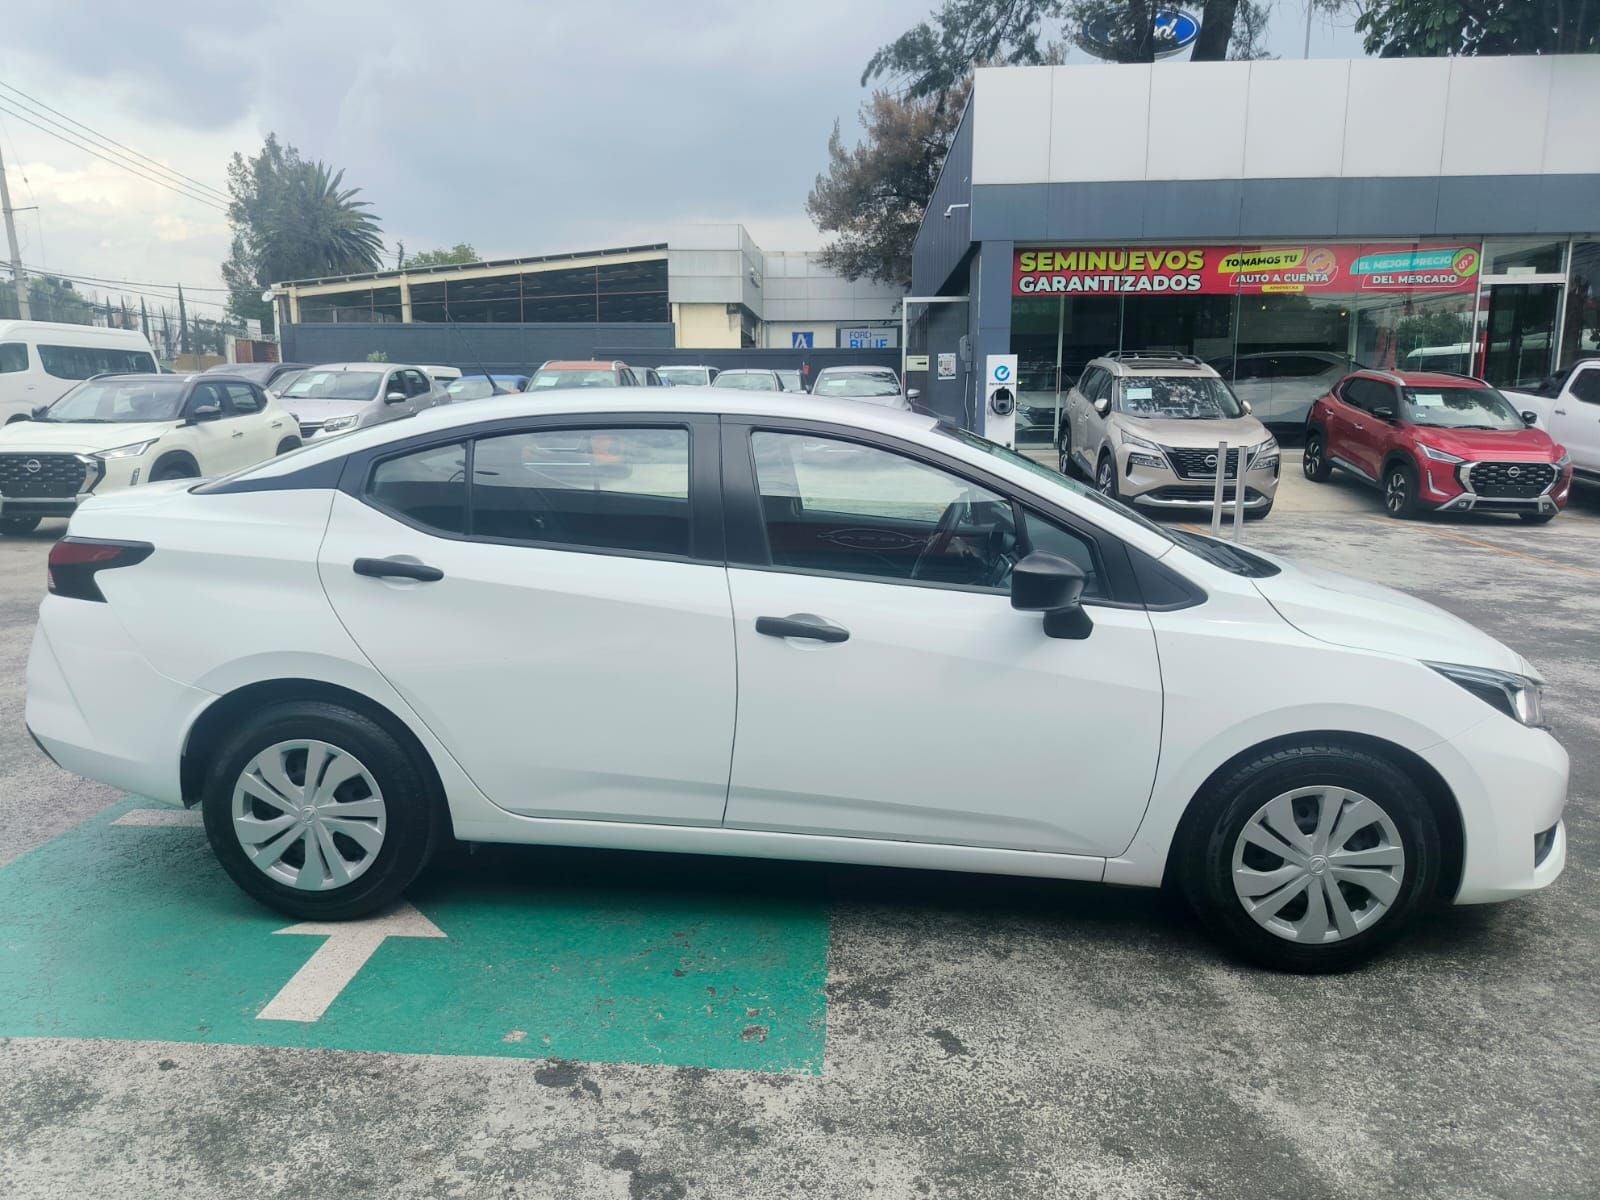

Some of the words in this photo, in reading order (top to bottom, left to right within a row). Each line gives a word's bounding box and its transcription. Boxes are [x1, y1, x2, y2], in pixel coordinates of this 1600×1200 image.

[1019, 250, 1204, 271] SEMINUEVOS
[1225, 256, 1281, 267] TOMAMOS
[1283, 254, 1298, 264] TU
[1359, 261, 1371, 270] EL
[1373, 259, 1410, 269] MEJOR
[1412, 256, 1452, 266] PRECIO
[1019, 274, 1202, 293] GARANTIZADOS
[1236, 273, 1270, 283] AUTO
[1273, 273, 1281, 282] A
[1283, 273, 1329, 283] CUENTA
[1372, 275, 1395, 284] DEL
[1398, 274, 1458, 284] MERCADO
[849, 330, 872, 339] FORD
